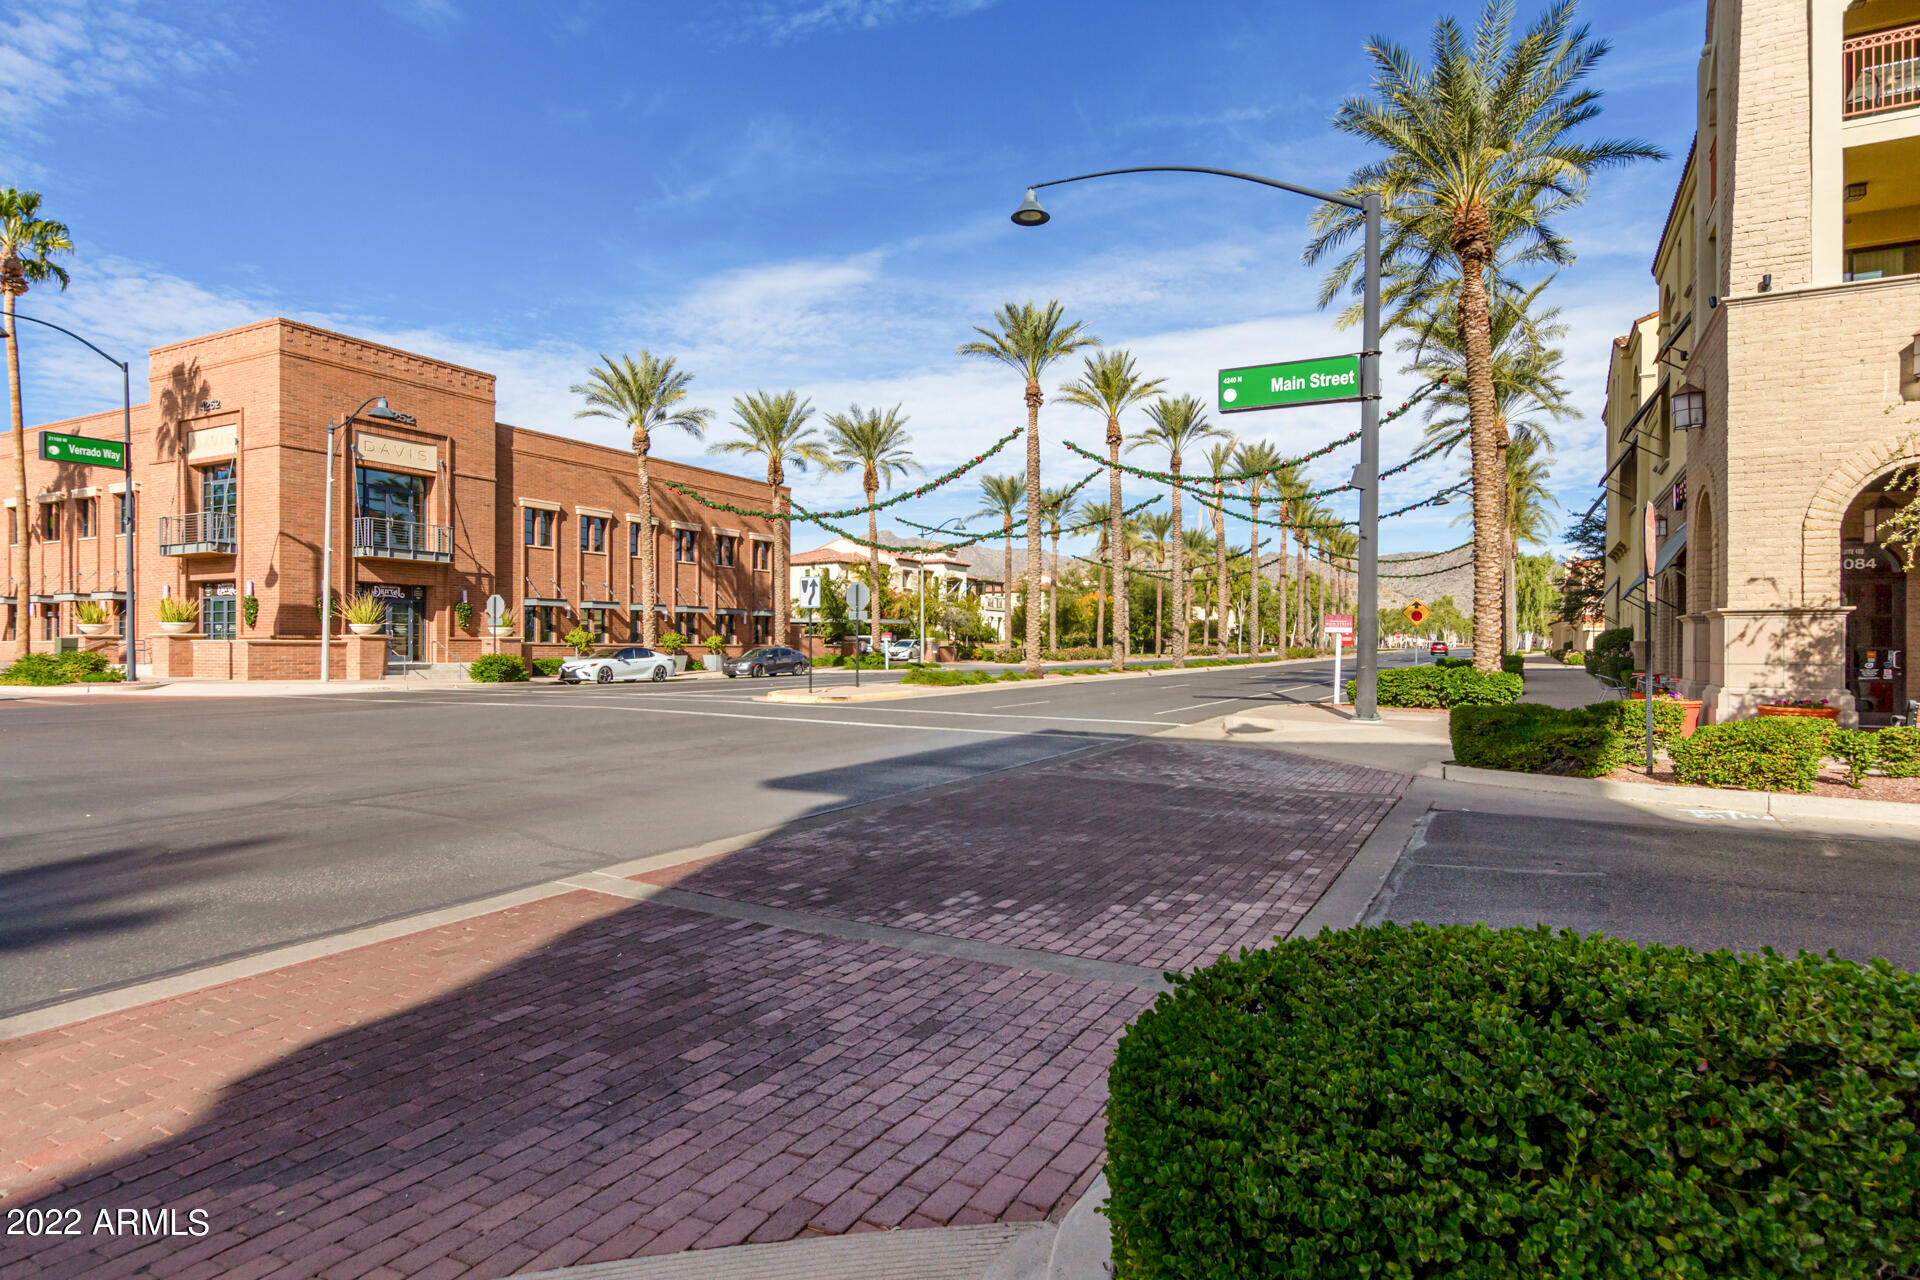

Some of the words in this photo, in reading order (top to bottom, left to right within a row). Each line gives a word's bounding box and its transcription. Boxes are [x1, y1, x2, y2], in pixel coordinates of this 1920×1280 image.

[1270, 376, 1306, 392] Main
[1309, 370, 1355, 388] Street
[68, 444, 101, 458] Verrado
[102, 448, 121, 462] Way
[364, 440, 428, 461] DAVIS
